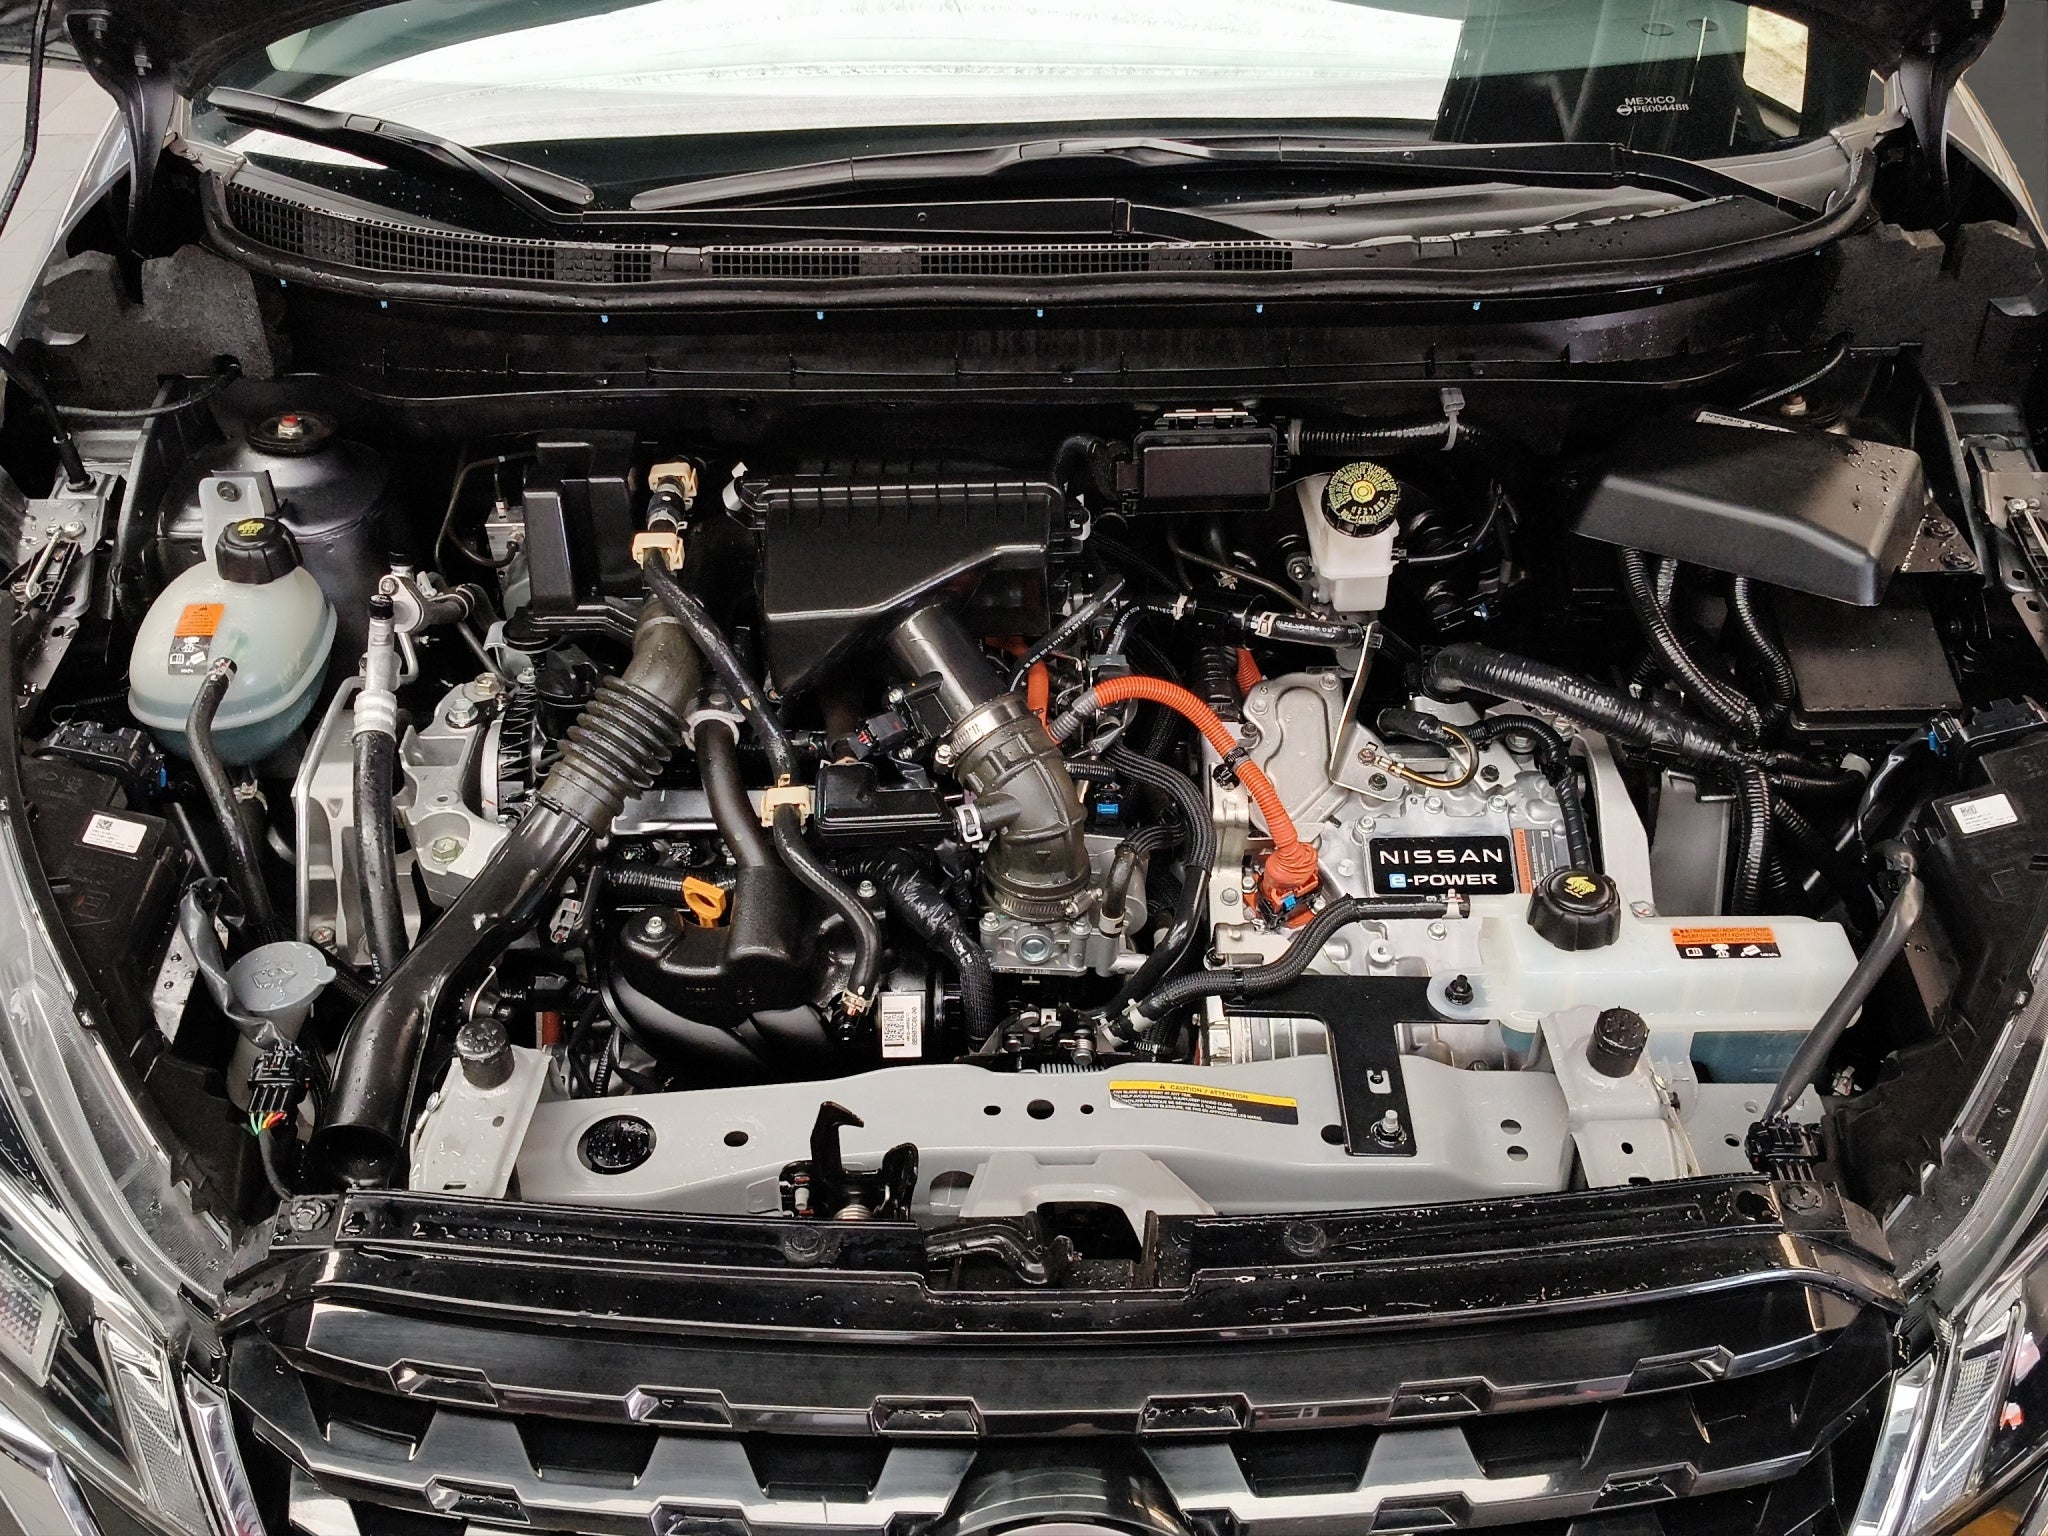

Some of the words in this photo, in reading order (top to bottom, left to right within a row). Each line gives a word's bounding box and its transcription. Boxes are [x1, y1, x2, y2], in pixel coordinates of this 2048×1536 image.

[1625, 96, 1675, 105] MEXICO
[1379, 849, 1503, 864] NISSAN
[1389, 874, 1498, 888] e-POWER
[1170, 1085, 1202, 1093] CAUTION
[1209, 1090, 1248, 1099] ATTENTION
